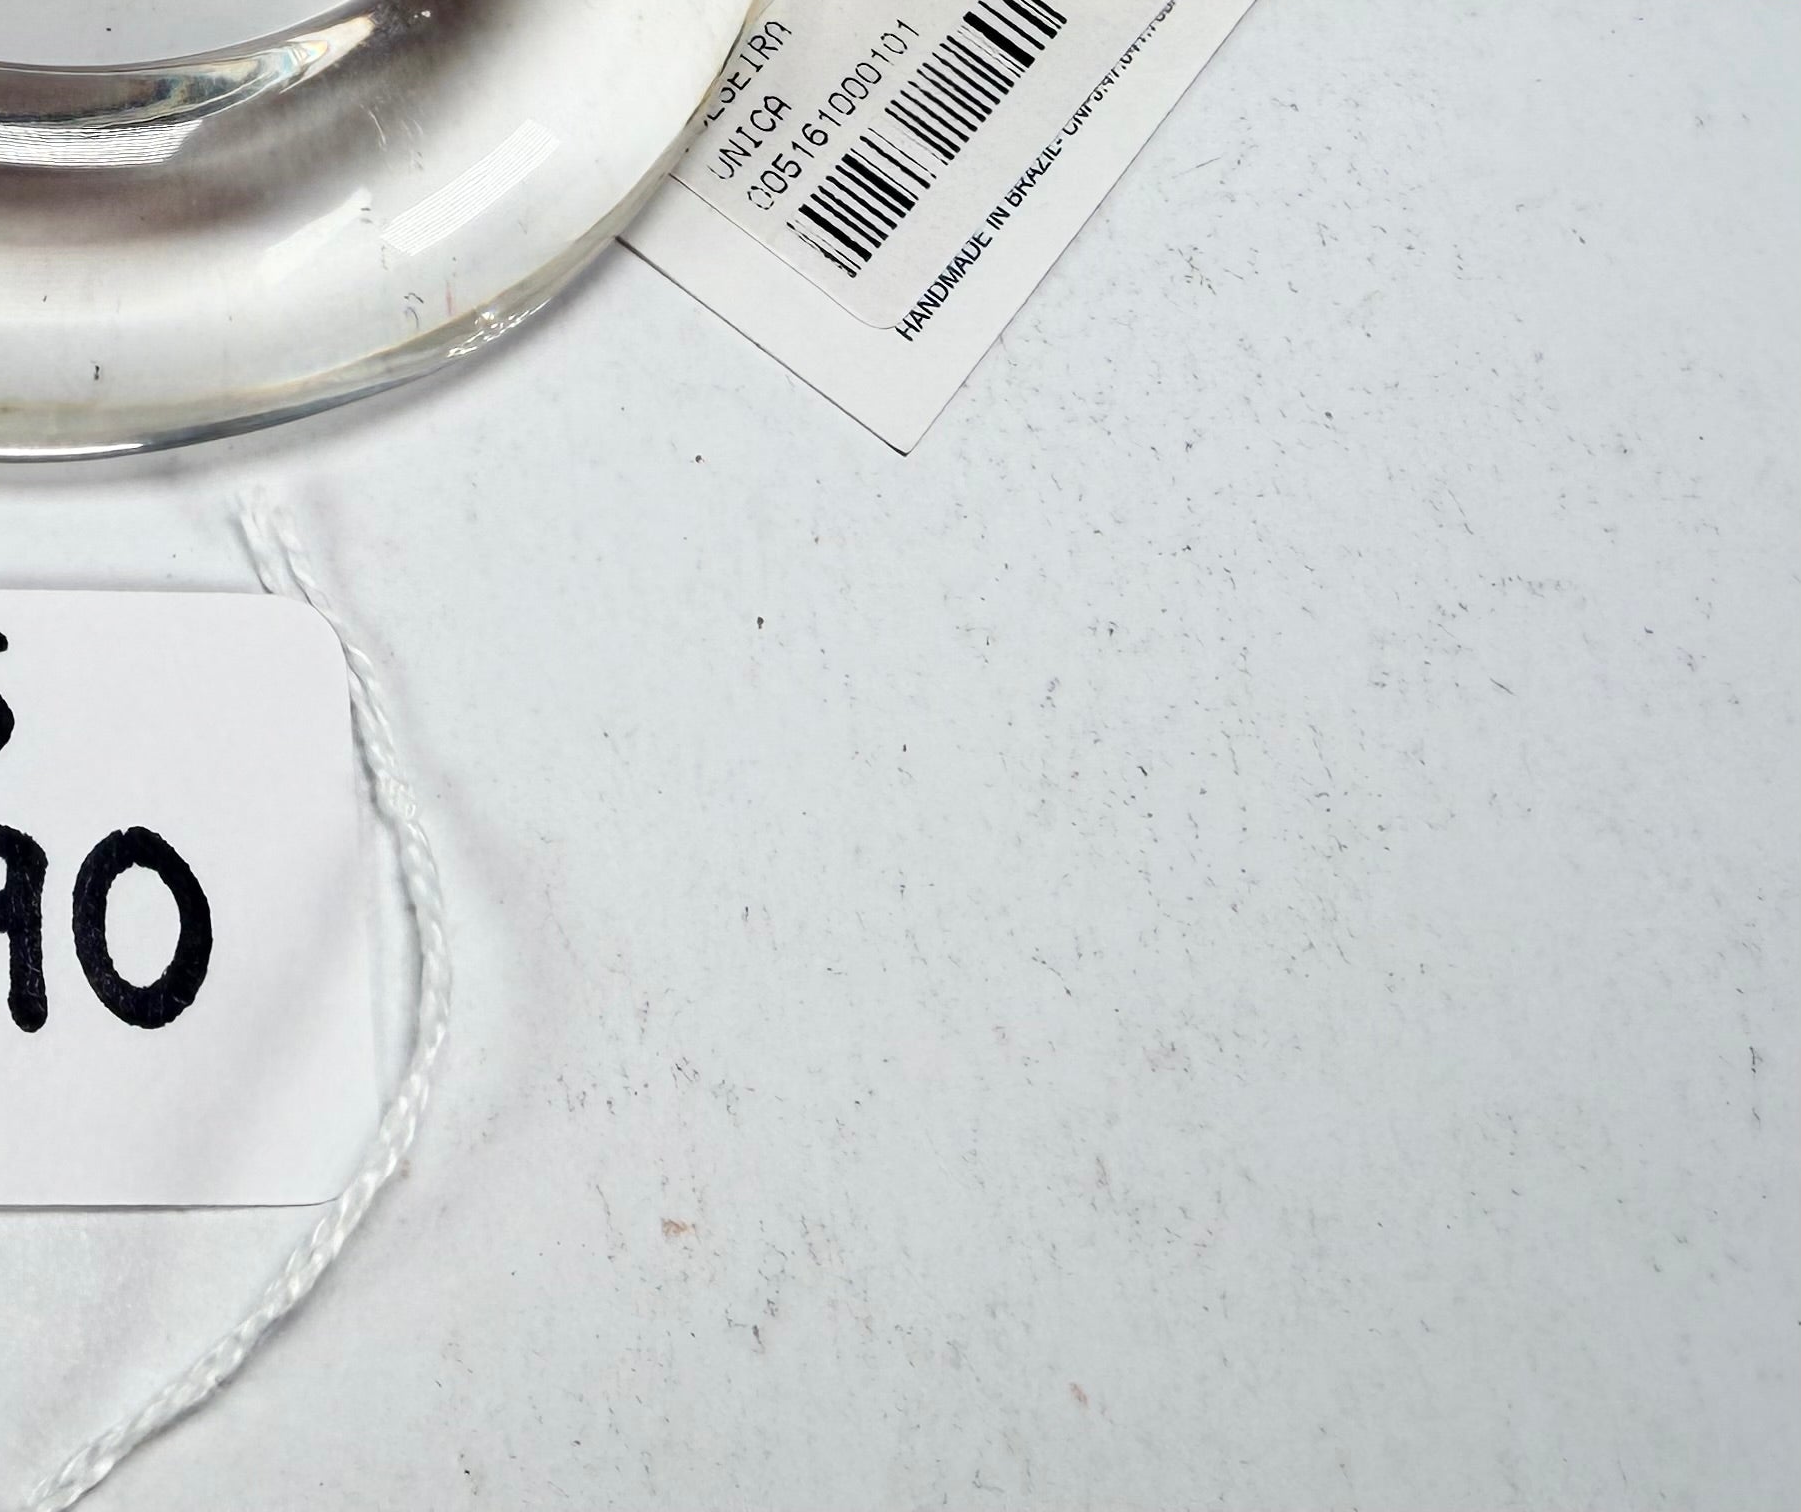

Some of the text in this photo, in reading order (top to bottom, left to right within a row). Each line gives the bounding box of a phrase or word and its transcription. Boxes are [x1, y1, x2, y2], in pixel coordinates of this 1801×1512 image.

[706, 95, 792, 180] UNICA
[747, 19, 920, 210] 005161000101
[894, 231, 993, 341] HANDMADE
[986, 205, 1010, 230] IN
